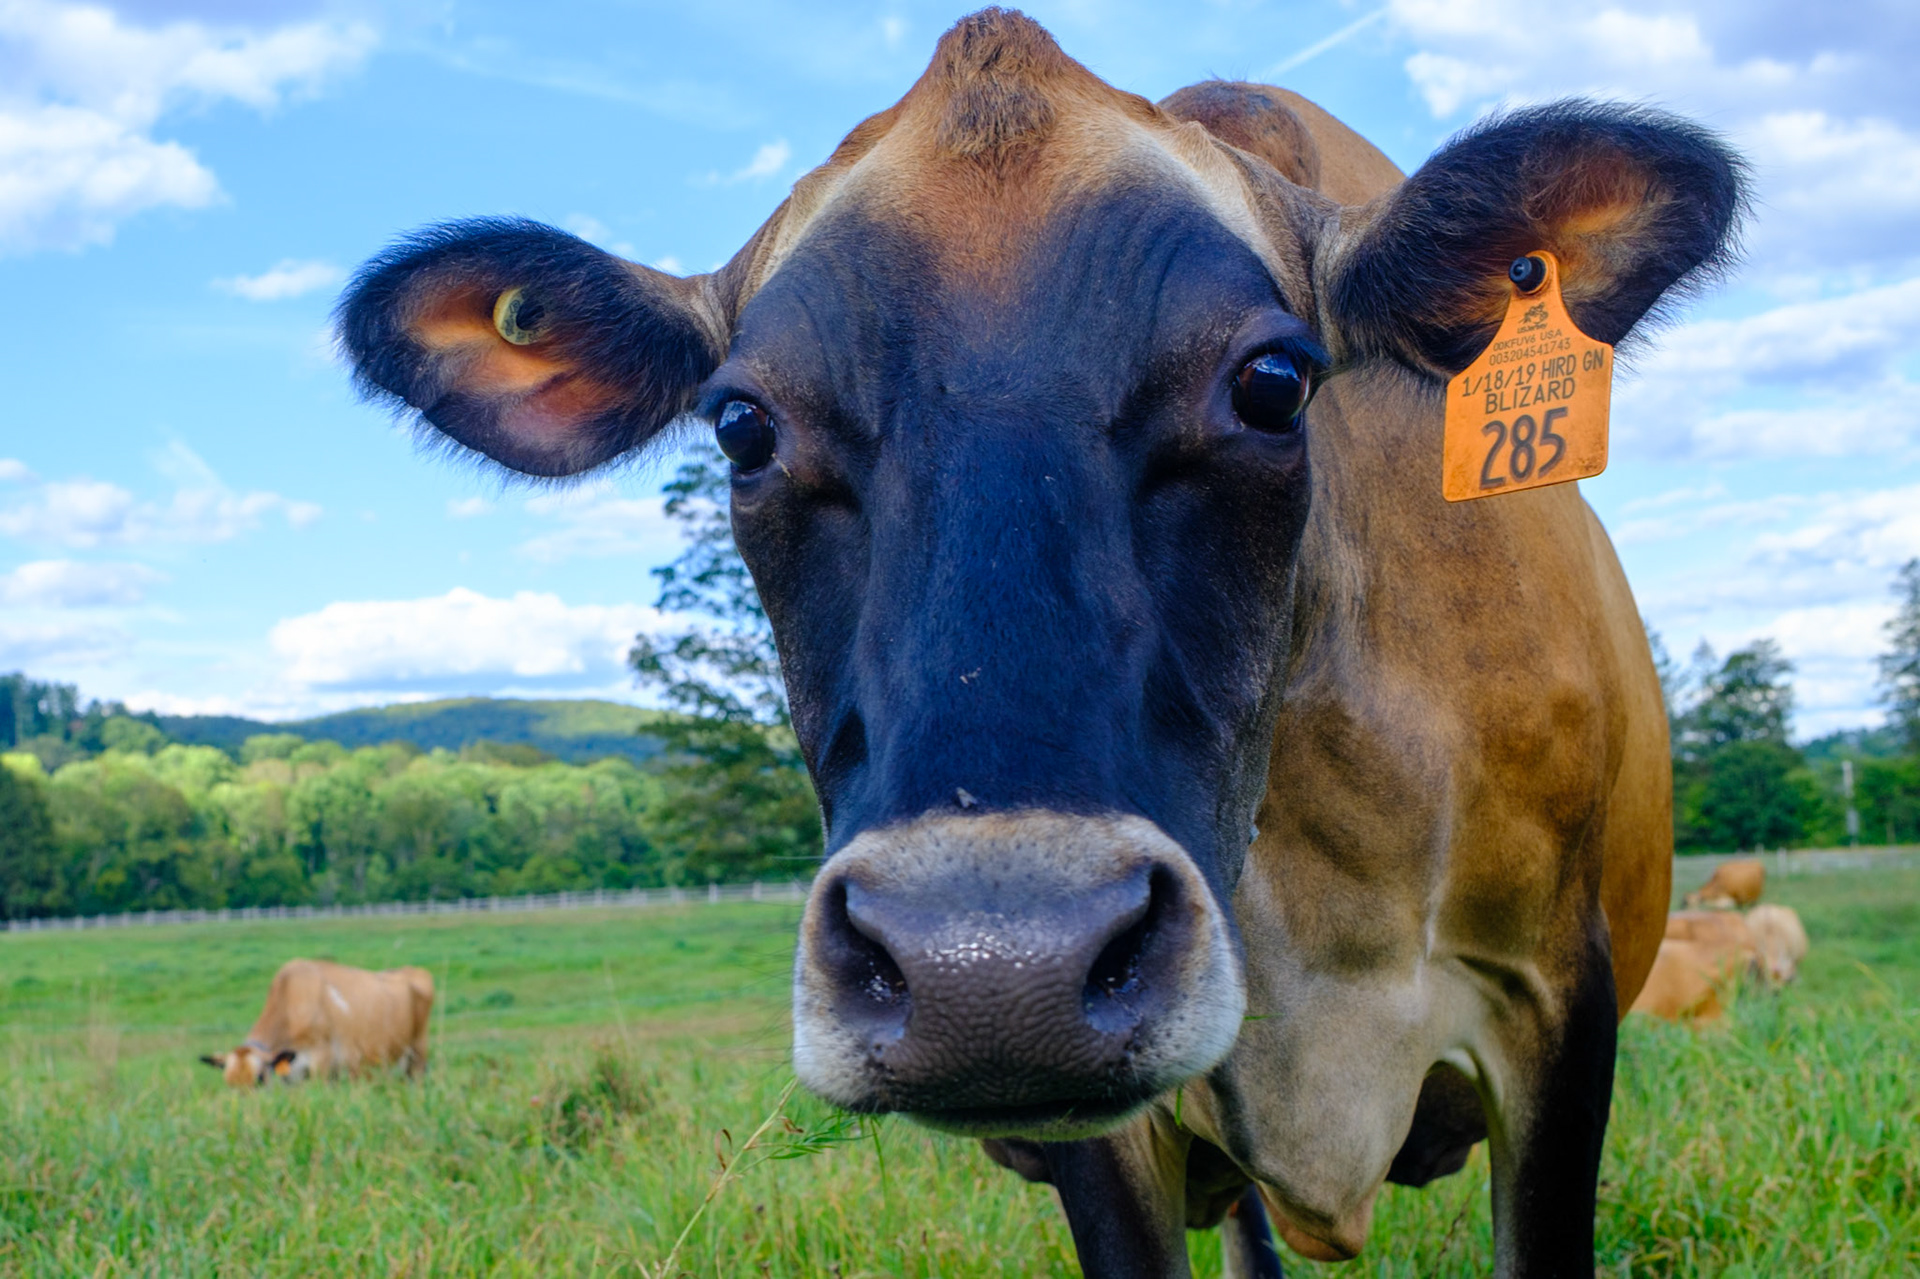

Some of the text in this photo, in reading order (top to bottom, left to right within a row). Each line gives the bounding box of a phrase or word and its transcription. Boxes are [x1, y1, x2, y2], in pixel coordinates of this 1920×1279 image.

[1489, 337, 1571, 366] 003204541743
[1540, 329, 1562, 341] USA
[1462, 362, 1536, 397] 1/18/19
[1583, 348, 1605, 372] GN
[1484, 377, 1576, 415] BLIZARD
[1479, 406, 1569, 490] 285
